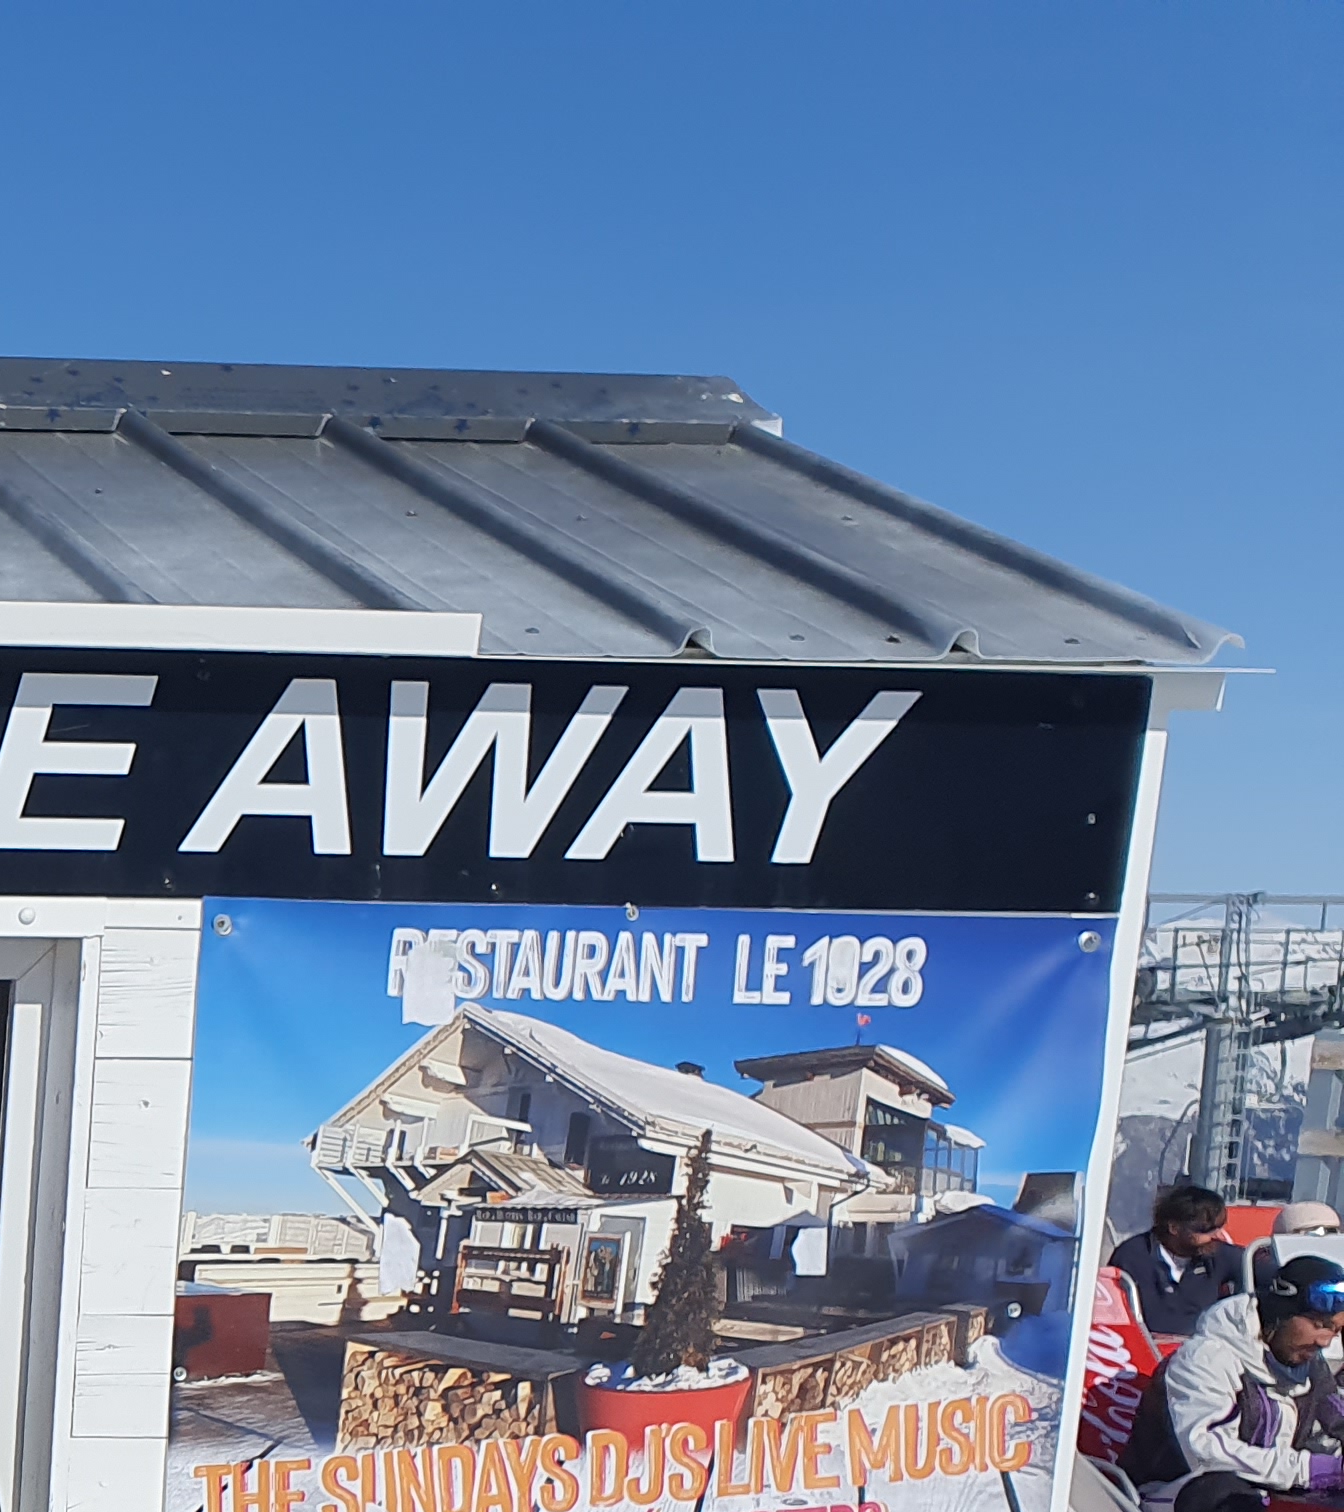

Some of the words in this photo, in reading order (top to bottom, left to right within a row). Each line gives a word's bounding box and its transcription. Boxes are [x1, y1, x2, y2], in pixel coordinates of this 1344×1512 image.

[178, 677, 924, 864] AWAY
[387, 927, 708, 1003] RSTAURANT
[732, 933, 796, 1006] LE
[715, 1411, 842, 1500] LIVE
[845, 1391, 1036, 1487] MUSIC
